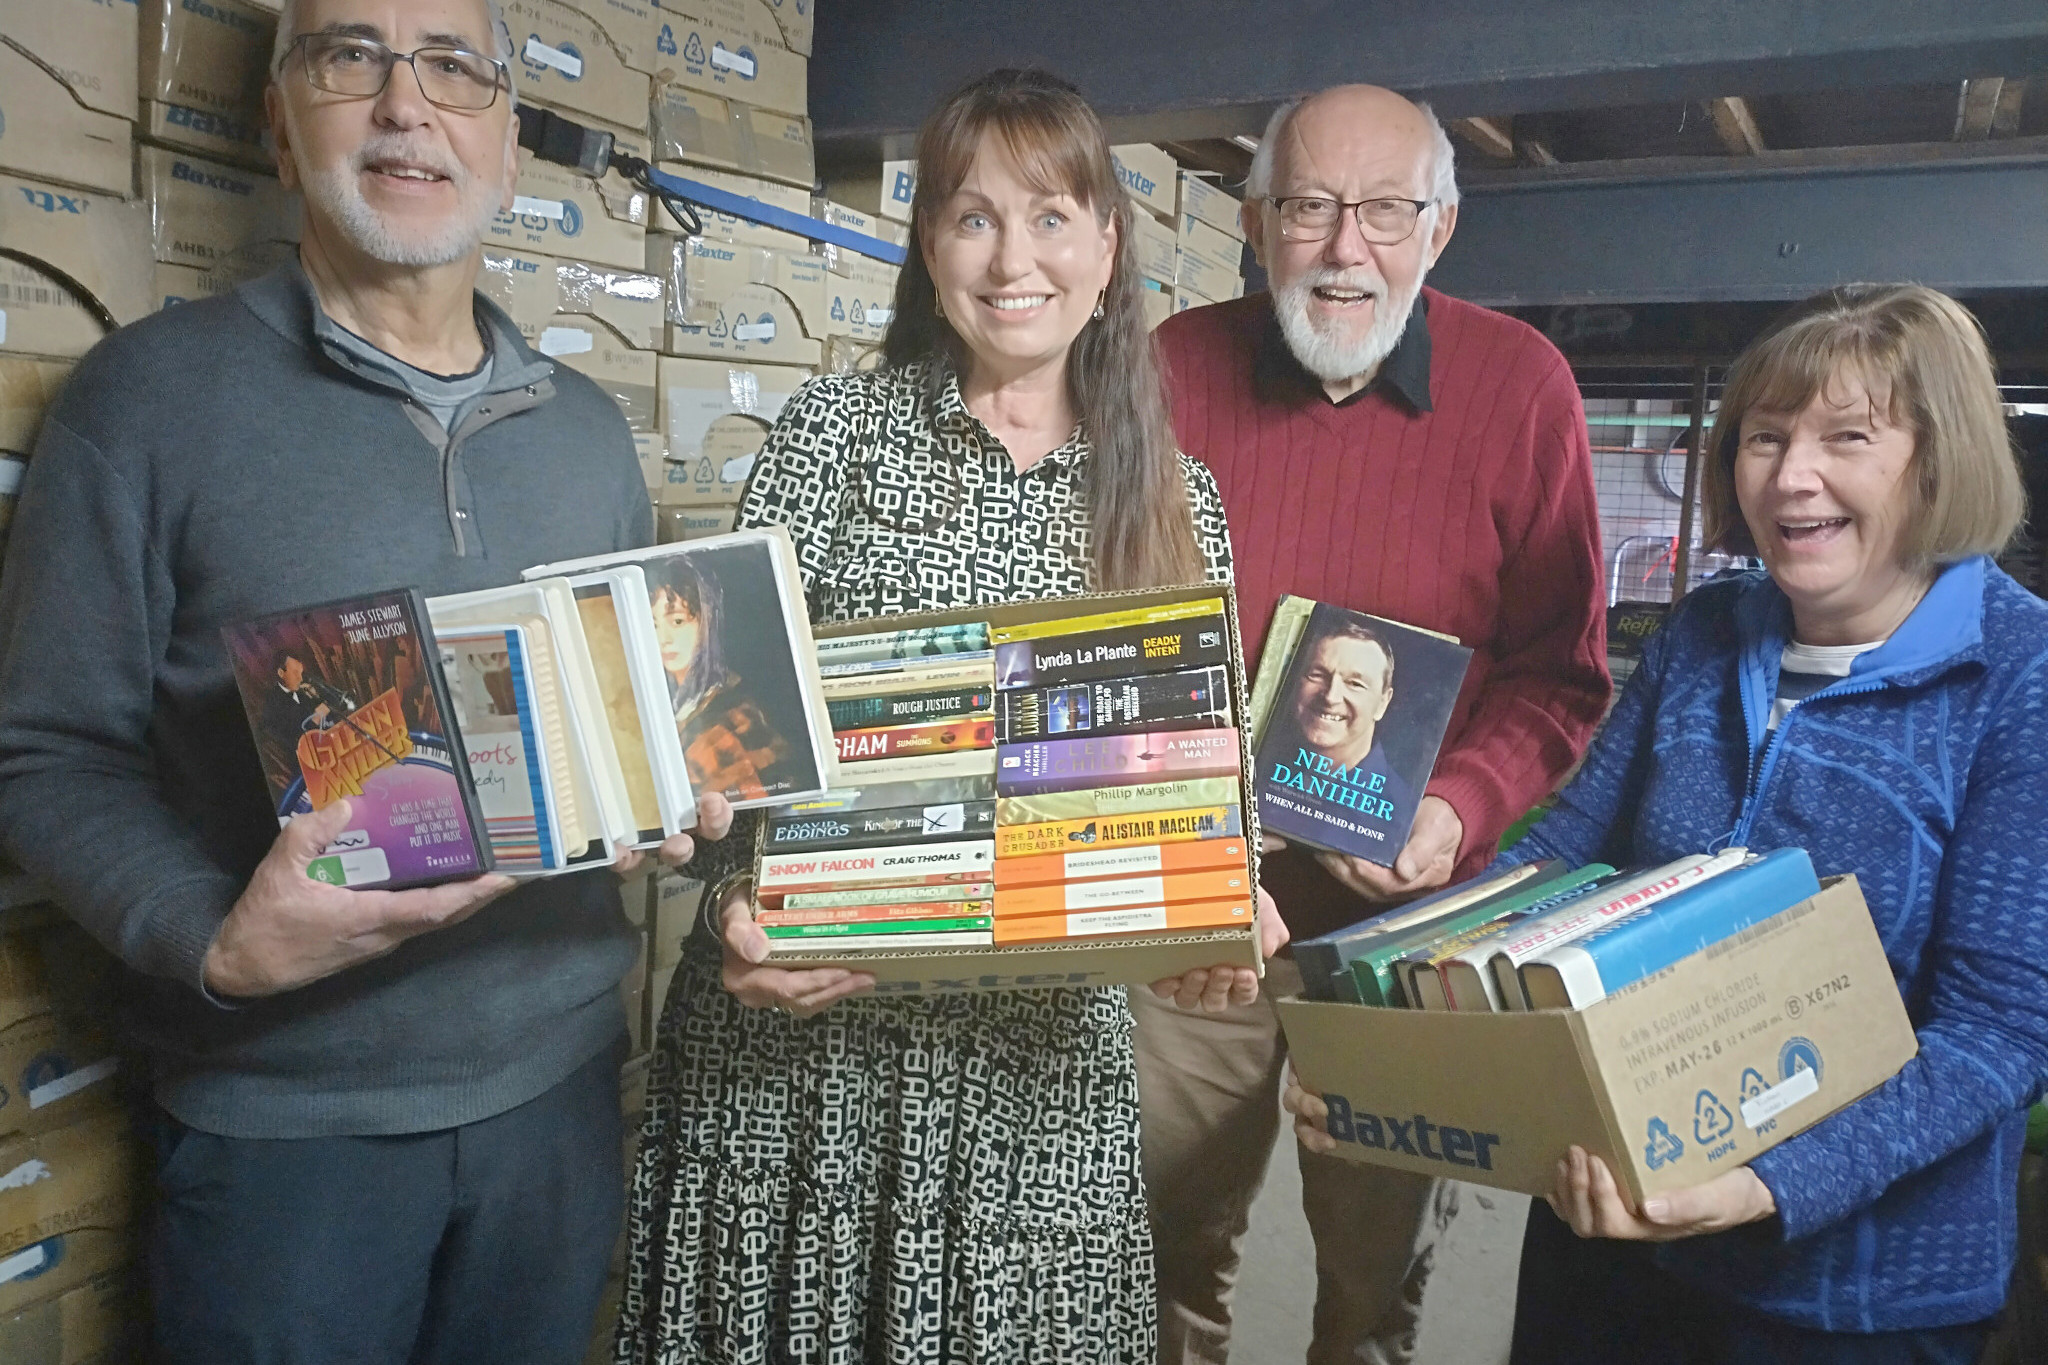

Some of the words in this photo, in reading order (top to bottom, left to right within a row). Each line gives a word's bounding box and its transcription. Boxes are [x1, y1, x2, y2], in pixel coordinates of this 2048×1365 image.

[525, 70, 542, 82] PVC
[686, 66, 703, 77] HDPE
[713, 74, 726, 84] PVC
[490, 225, 512, 237] HDPE
[526, 233, 543, 243] PVC
[339, 610, 366, 628] JAMES
[367, 604, 402, 623] STEWART
[347, 627, 371, 644] JUNE
[372, 621, 407, 639] ALLYSON
[1143, 634, 1181, 649] DEADLY
[1035, 652, 1072, 672] Lynda
[1077, 649, 1092, 663] La
[1096, 644, 1138, 662] Plante
[1145, 645, 1182, 658] INTENT
[1095, 684, 1103, 694] TO
[893, 701, 923, 715] ROUGH
[925, 697, 961, 712] JUSTICE
[1096, 695, 1104, 714] ROAD
[1115, 698, 1124, 711] THE
[1131, 686, 1140, 718] WEEKEND
[1096, 714, 1105, 727] THE
[833, 733, 889, 758] SHAM
[896, 737, 932, 748] SUMMONS
[1069, 741, 1112, 757] LEE
[1167, 741, 1175, 750] A
[1178, 737, 1228, 749] WANTED
[468, 741, 518, 766] oots
[1032, 744, 1040, 777] REACHER
[1184, 749, 1212, 759] MAN
[322, 726, 414, 803] MILLER
[1055, 755, 1128, 773] CHILD
[1293, 748, 1387, 794] NEALE
[474, 769, 506, 793] edy
[1094, 788, 1132, 800] Phillip
[1136, 783, 1188, 796] Margolin
[1270, 763, 1395, 821] DANIHER
[389, 811, 420, 827] CHANGED
[790, 820, 838, 830] DAVID
[1265, 792, 1294, 810] WHEN
[1294, 805, 1313, 817] ALL
[1314, 810, 1324, 821] IS
[1324, 814, 1348, 829] SAID
[1347, 823, 1356, 832] &
[1356, 826, 1385, 842] DONE
[414, 822, 429, 835] AND
[429, 820, 443, 832] ONE
[775, 824, 851, 841] EDDINGS
[1003, 833, 1024, 843] THE
[1027, 827, 1065, 840] DARK
[1102, 820, 1155, 841] ALISTAIR
[1159, 813, 1214, 835] MACLEAN
[409, 835, 423, 848] PUT
[423, 833, 432, 846] IT
[432, 832, 442, 844] TO
[1003, 840, 1065, 853] CRUSADER
[768, 862, 816, 876] SNOW
[821, 858, 875, 873] FALCON
[883, 856, 915, 866] CRAIG
[918, 853, 961, 863] THOMAS
[1067, 859, 1116, 868] BRIDESHEAD
[1118, 855, 1158, 863] REVISITED
[907, 887, 948, 897] HUMOUR
[875, 971, 1104, 992] axter
[1652, 1002, 1701, 1035] SODIUM
[1704, 972, 1762, 1010] CHLORIDE
[1625, 1020, 1710, 1071] INTRAVENOUS
[1712, 992, 1768, 1029] INFUSION
[1664, 1040, 1723, 1080] MAY-26
[1805, 974, 1852, 1008] X67N2
[1704, 1106, 1719, 1129] 2
[1322, 1092, 1500, 1170] Baxter
[1754, 1118, 1778, 1138] PVC
[1706, 1139, 1738, 1163] HDPE
